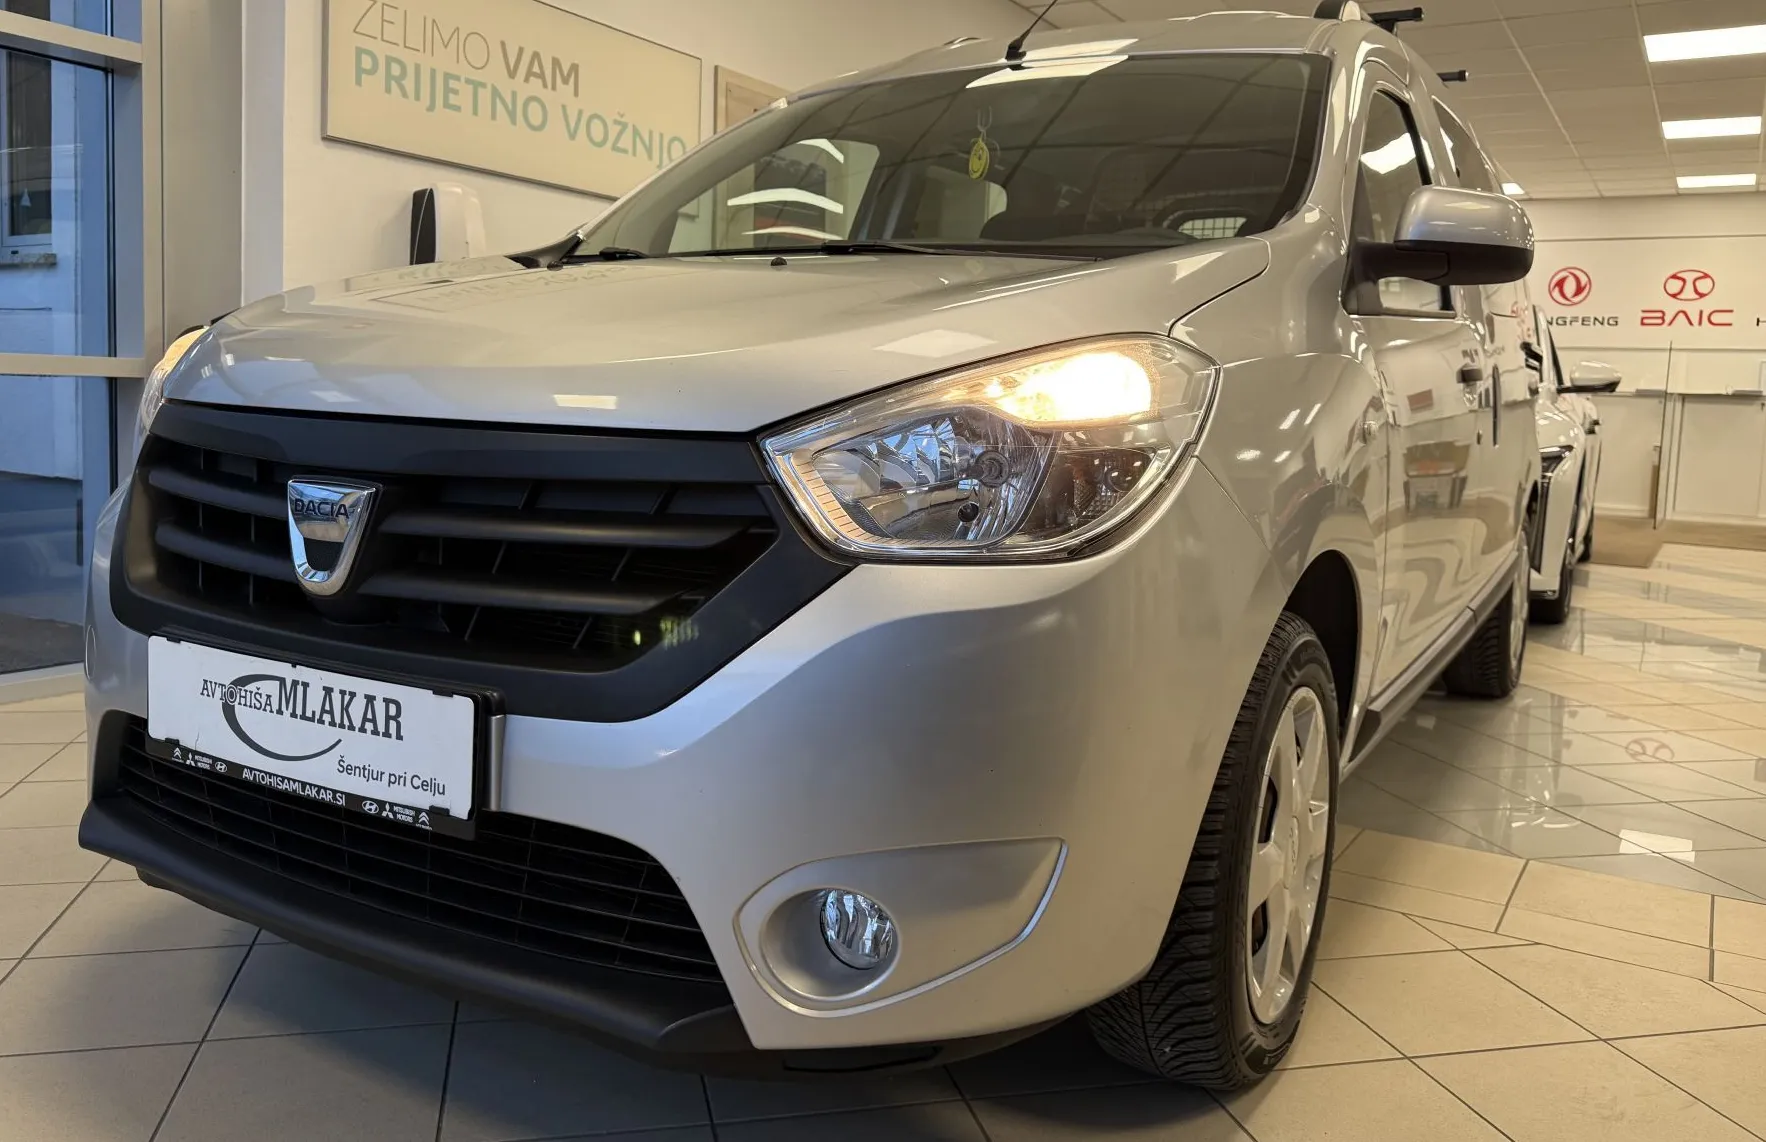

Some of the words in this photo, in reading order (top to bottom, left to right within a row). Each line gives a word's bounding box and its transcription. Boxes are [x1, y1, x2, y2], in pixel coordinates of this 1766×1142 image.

[500, 40, 580, 98] VAM
[354, 46, 549, 132] PRIJETNO
[561, 104, 687, 170] VOŽNJO
[1547, 316, 1619, 326] NGFENG
[1640, 309, 1734, 326] BAIC
[294, 498, 350, 519] DACIA
[276, 678, 404, 741] MLAKAR
[242, 766, 346, 807] AVTOHISAMLAKAR.SI
[337, 754, 386, 783] Šentjur
[388, 771, 407, 788] pri
[410, 774, 446, 796] Celju
